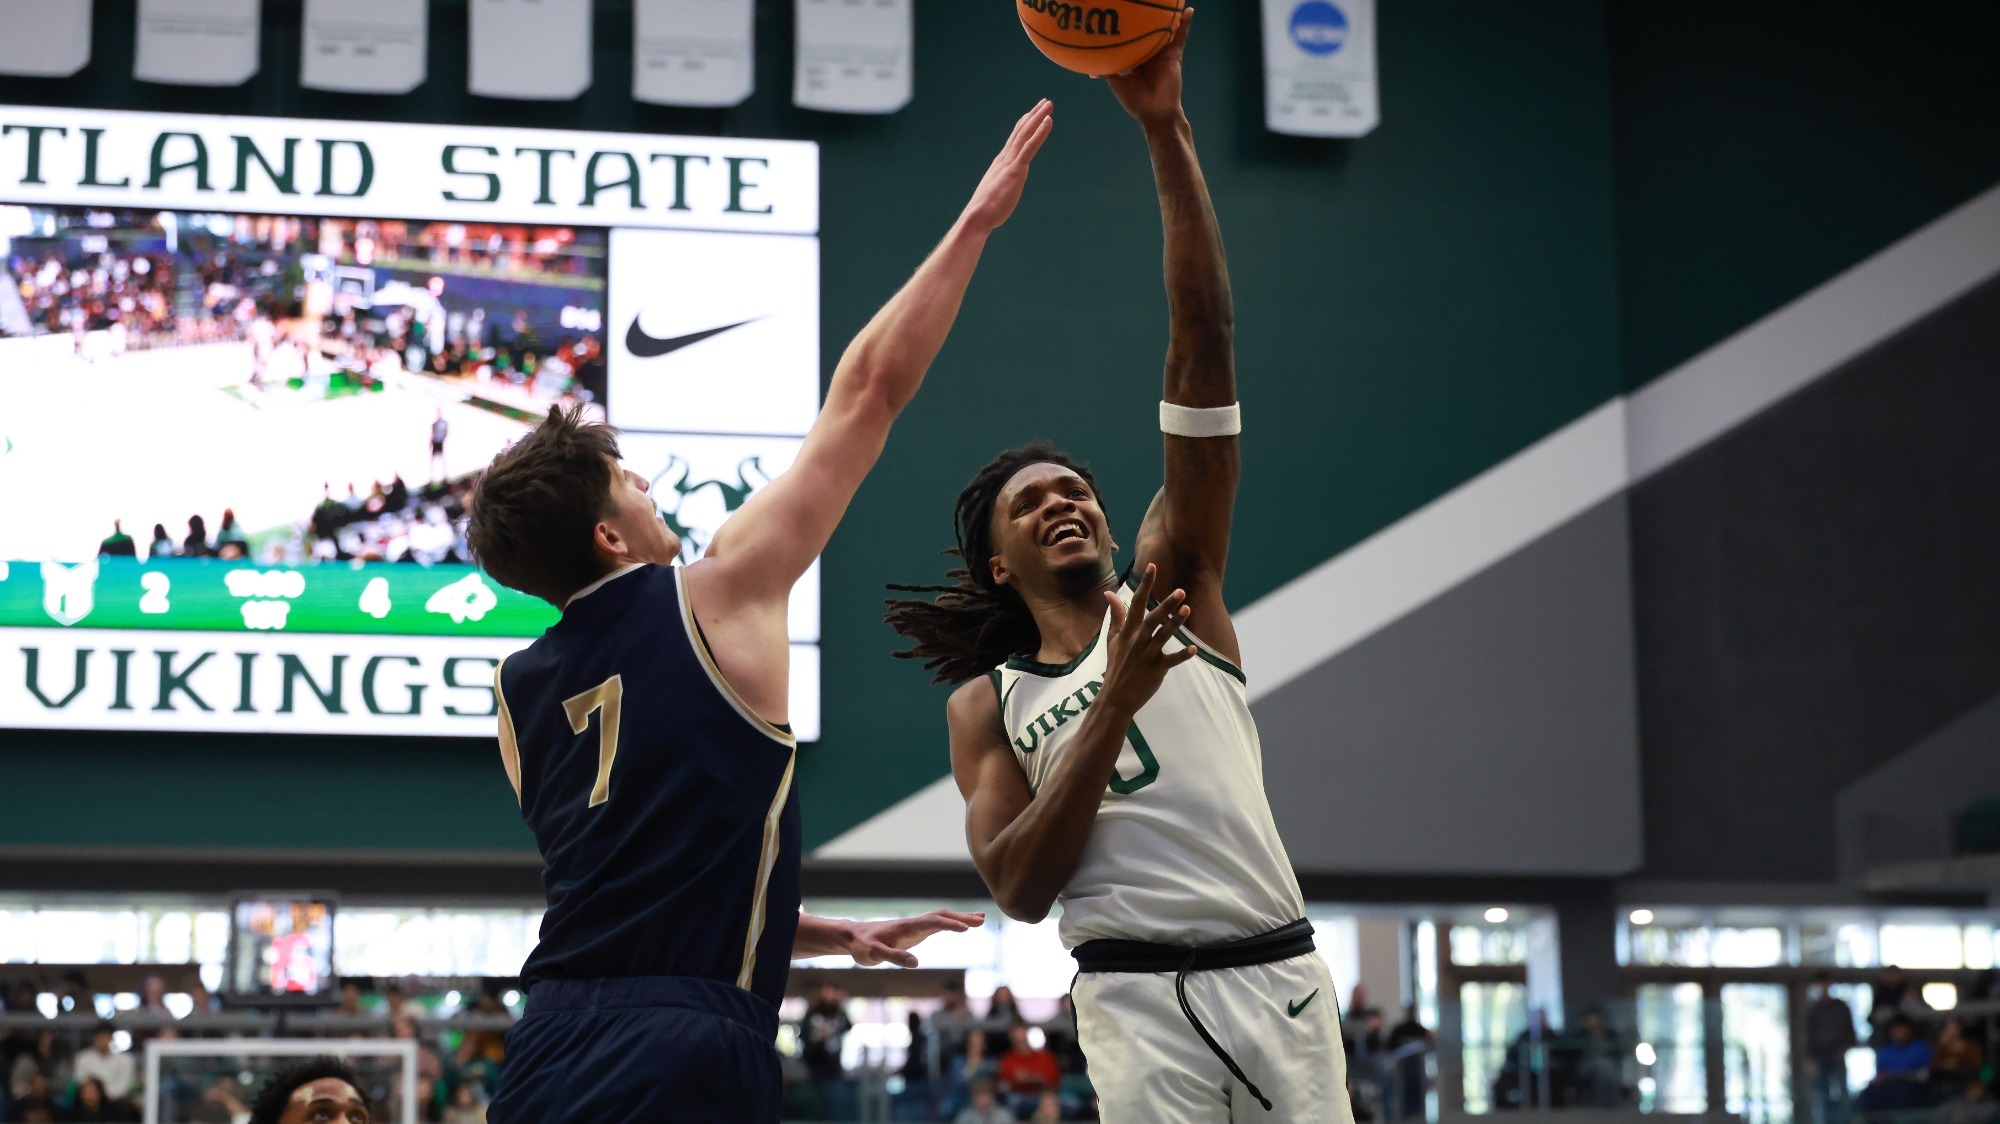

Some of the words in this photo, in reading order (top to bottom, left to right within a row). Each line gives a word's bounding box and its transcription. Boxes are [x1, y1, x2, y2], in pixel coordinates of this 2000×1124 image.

[2, 125, 374, 197] TLAND
[441, 144, 773, 214] STATE
[139, 571, 170, 613] 2
[359, 577, 392, 618] 4
[20, 647, 499, 716] VIKINGS
[561, 673, 623, 809] 7
